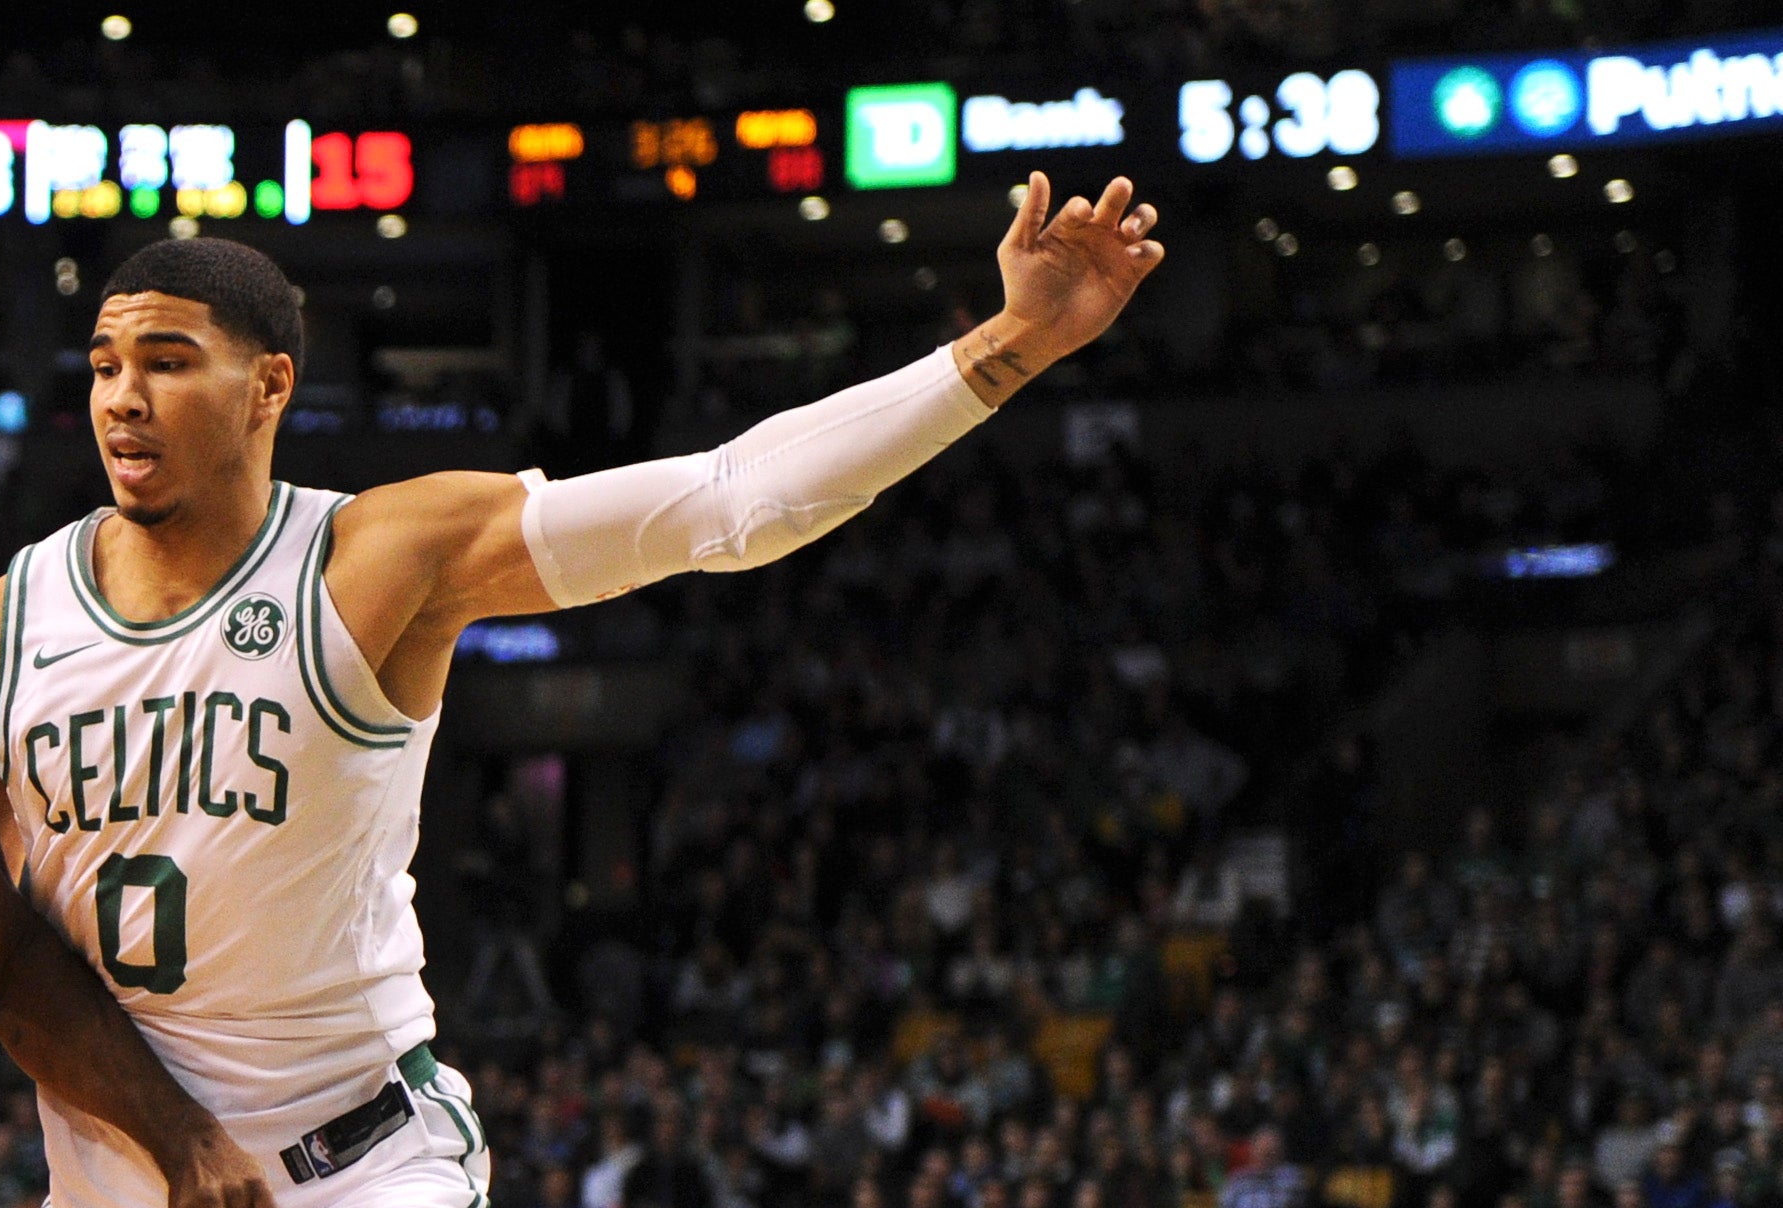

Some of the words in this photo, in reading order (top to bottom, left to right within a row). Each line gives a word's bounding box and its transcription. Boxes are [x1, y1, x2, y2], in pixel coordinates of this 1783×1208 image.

[855, 101, 947, 167] TD
[1587, 47, 1783, 136] Putn
[311, 131, 414, 210] 15
[25, 691, 291, 834] CELTICS
[95, 852, 188, 995] 0
